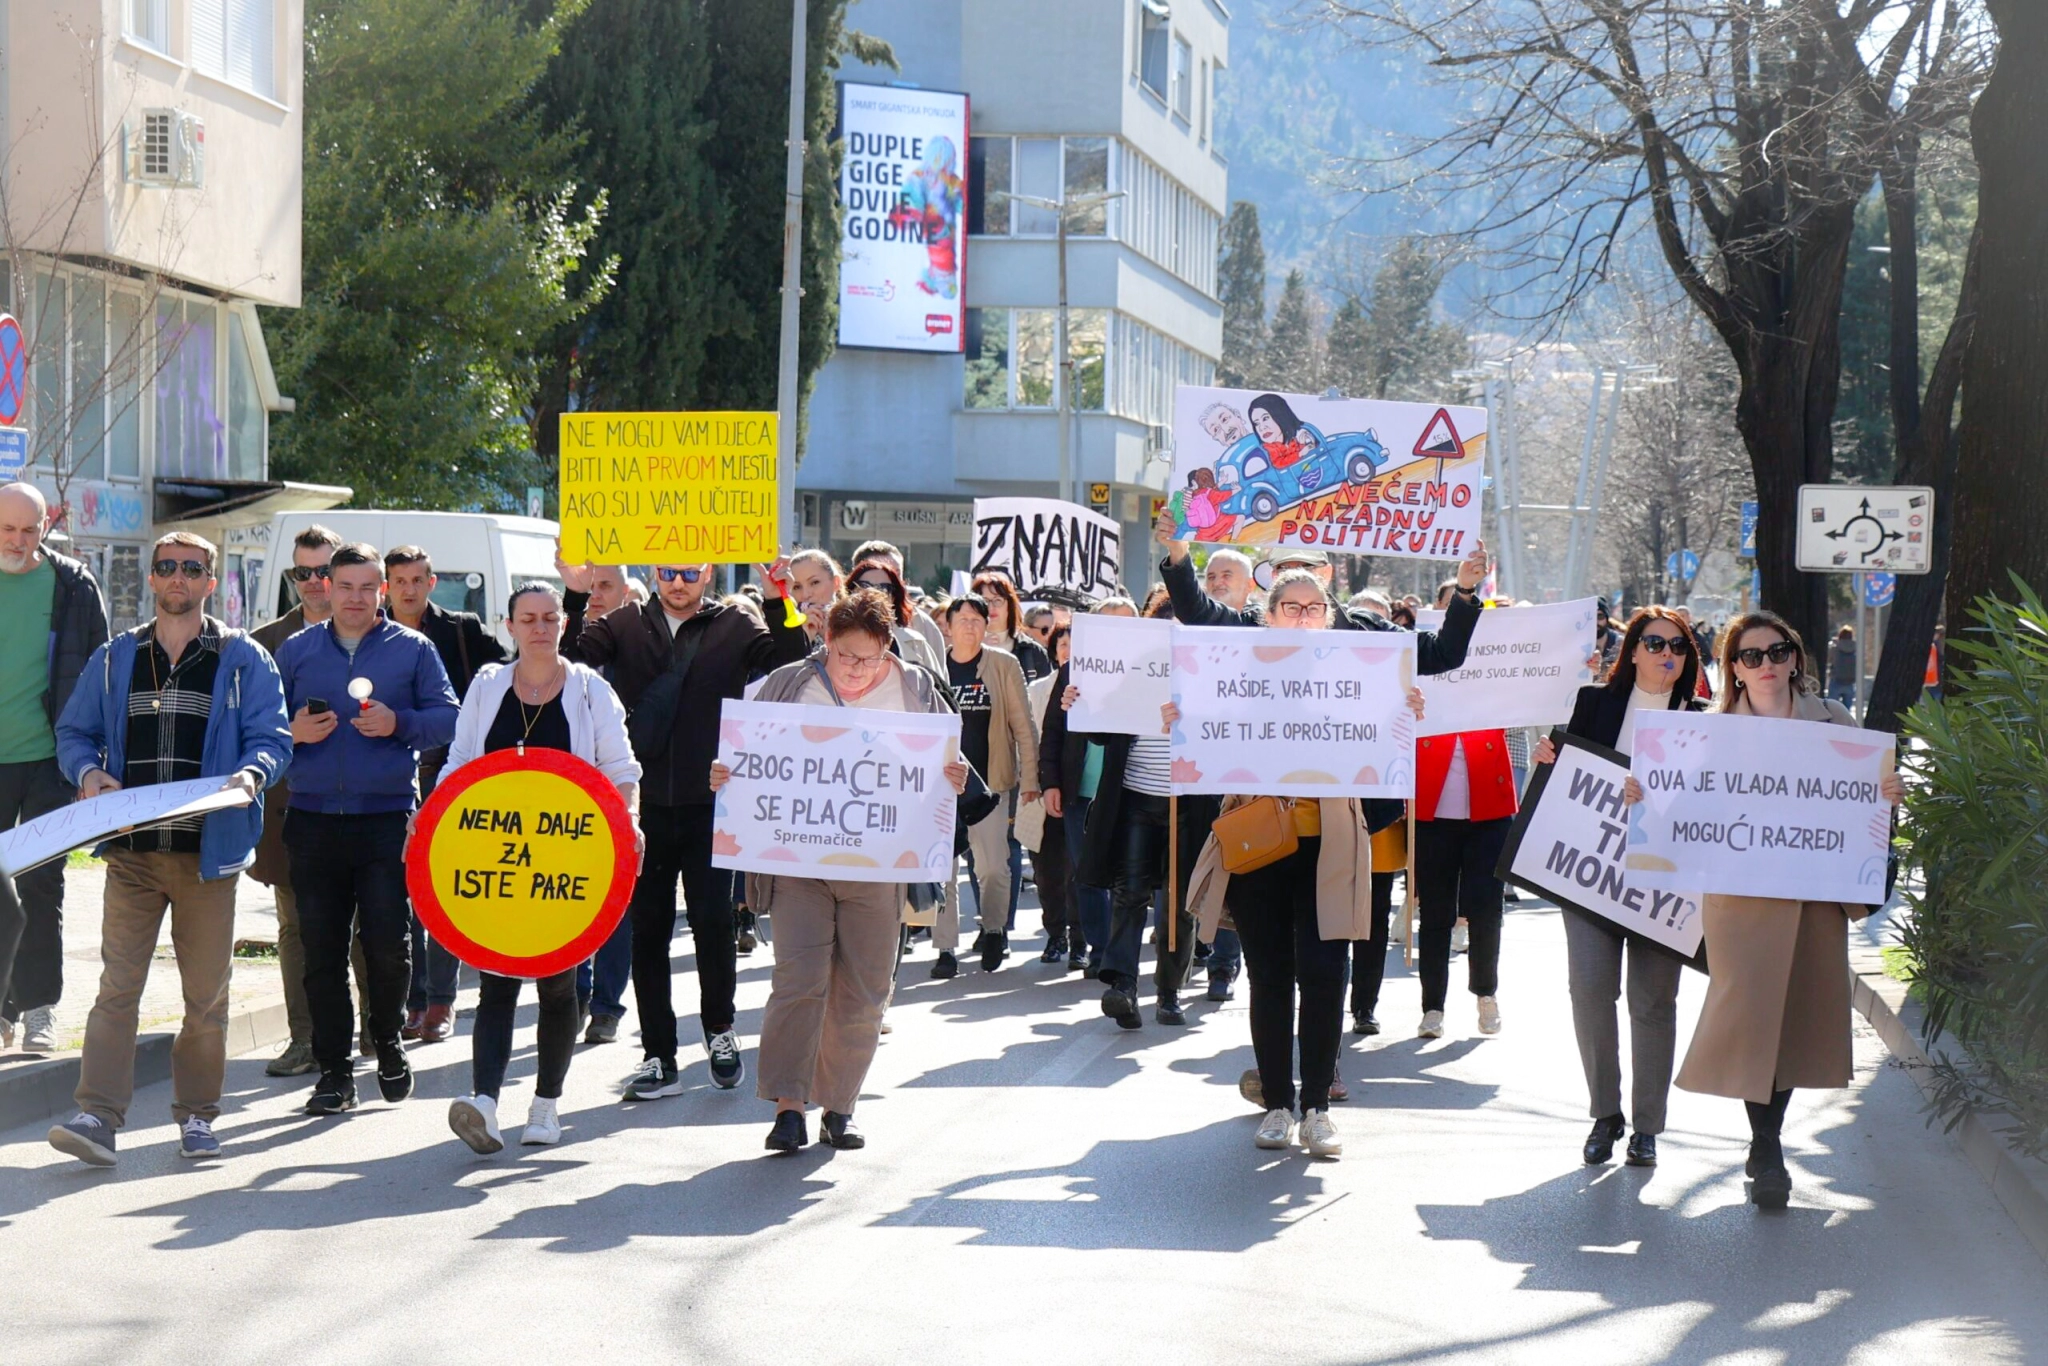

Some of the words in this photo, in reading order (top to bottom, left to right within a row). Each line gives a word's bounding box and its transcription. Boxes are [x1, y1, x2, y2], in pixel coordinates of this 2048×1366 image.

[850, 132, 922, 160] DUPLE
[850, 160, 903, 186] GIGE
[850, 188, 911, 215] DVIJE
[848, 216, 938, 244] GODINE
[567, 420, 595, 448] NE
[606, 420, 664, 448] MOGU
[673, 420, 709, 446] VAM
[716, 420, 772, 446] DJECA
[566, 456, 601, 482] BITI
[612, 456, 642, 482] NA
[648, 456, 715, 482] PRVOM
[722, 454, 776, 481] MJESTU
[565, 492, 606, 518] AKO
[612, 490, 640, 517] SU
[650, 490, 688, 515] VAM
[699, 486, 771, 517] UČITELJI
[1334, 471, 1471, 508] NEĆEMO
[1296, 500, 1436, 530] NAZADNU
[586, 527, 623, 555] NA
[644, 522, 773, 555] ZADNJEM!
[972, 513, 1120, 592] ZNANJE
[1278, 520, 1464, 556] POLITIKU!!!
[1475, 644, 1506, 657] NISMO
[1511, 643, 1541, 654] OVCE!
[1073, 657, 1125, 674] MARIJA
[1486, 668, 1519, 679] SVOJE
[1523, 666, 1560, 677] NOVCE!
[1216, 672, 1274, 700] RAŠIDE,
[1282, 680, 1328, 699] VRATI
[1335, 680, 1361, 700] SE!!
[1201, 722, 1230, 740] SVE
[1238, 722, 1252, 741] TI
[1258, 722, 1276, 740] JE
[1283, 716, 1377, 742] OPROŠTENO!
[730, 752, 793, 781] ZBOG
[803, 750, 890, 796] PLAĆE
[900, 765, 924, 793] MI
[1648, 769, 1685, 792] OVA
[1694, 771, 1715, 792] JE
[1724, 772, 1788, 796] VLADA
[1797, 777, 1878, 804] NAJGORI
[1568, 767, 1628, 824] WH
[458, 808, 522, 835] NEMA
[536, 811, 594, 840] DALJE
[754, 795, 782, 821] SE
[791, 789, 897, 836] PLAČE!!!
[774, 829, 863, 847] Spremačice
[1672, 814, 1754, 852] MOGUĆI
[1761, 825, 1845, 853] RAZRED!
[497, 842, 532, 868] ZA
[454, 869, 516, 899] ISTE
[530, 872, 589, 901] PARE
[1545, 840, 1696, 932] MONEY!?
